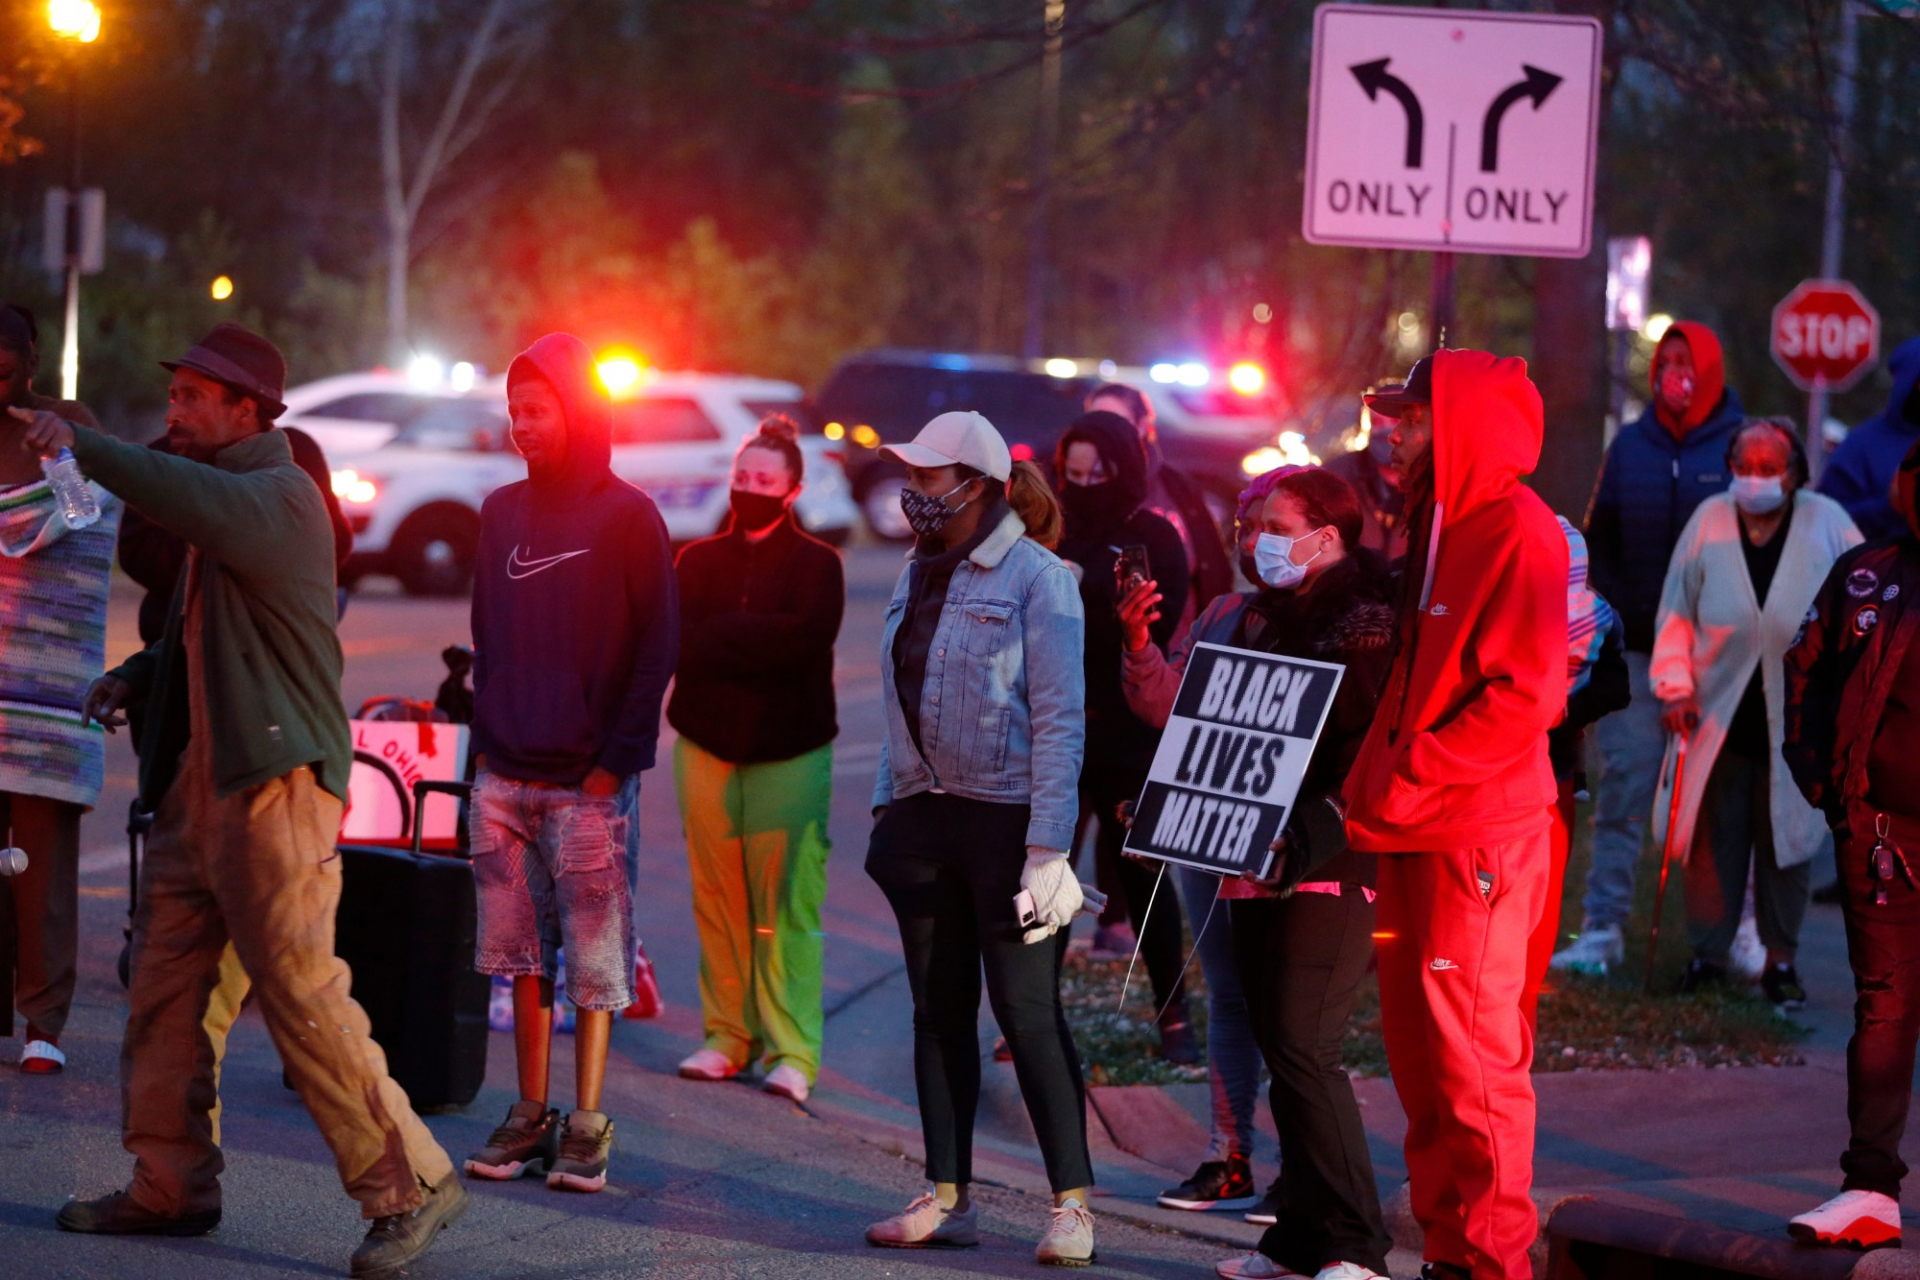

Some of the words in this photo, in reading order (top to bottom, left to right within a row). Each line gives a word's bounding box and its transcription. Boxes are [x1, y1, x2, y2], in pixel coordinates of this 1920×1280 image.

[1328, 179, 1431, 217] ONLY
[1465, 186, 1568, 225] ONLY
[1779, 313, 1869, 359] STOP
[1197, 656, 1314, 732] BLACK
[1174, 724, 1285, 797] LIVES
[1151, 790, 1261, 864] MATTER
